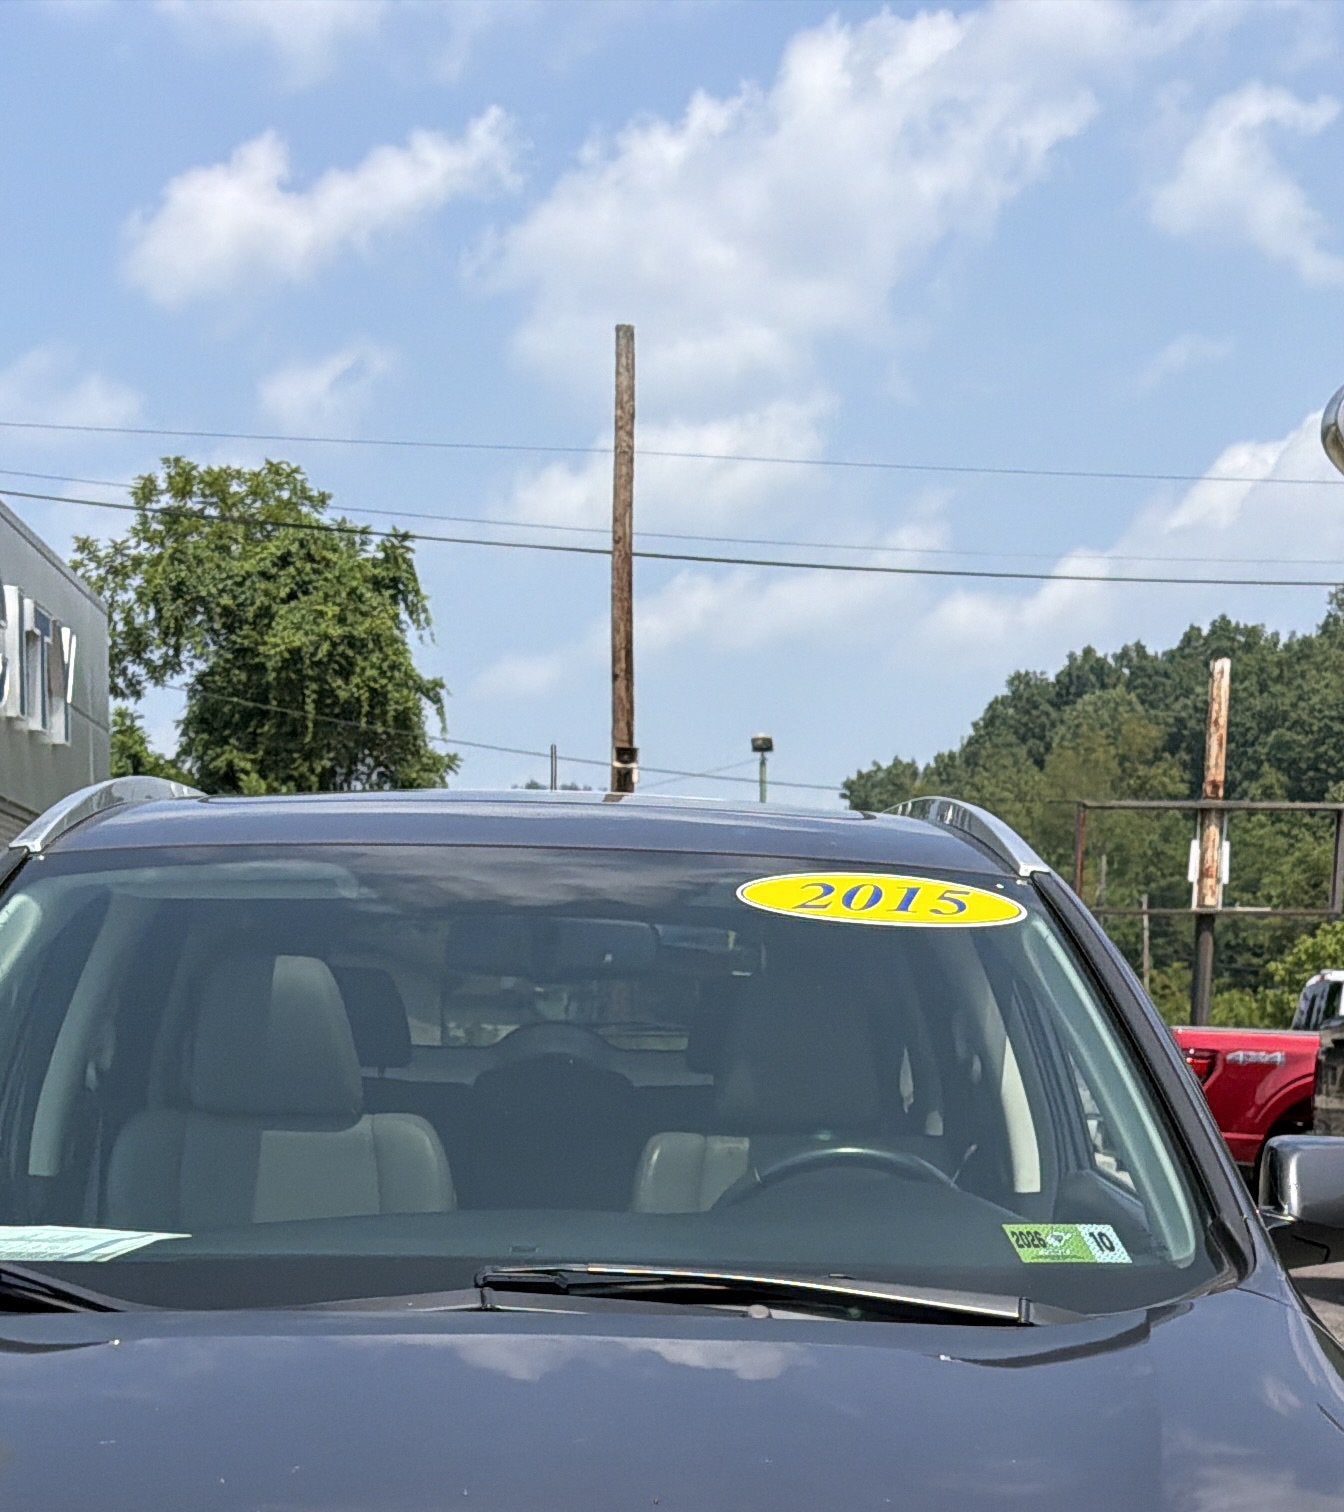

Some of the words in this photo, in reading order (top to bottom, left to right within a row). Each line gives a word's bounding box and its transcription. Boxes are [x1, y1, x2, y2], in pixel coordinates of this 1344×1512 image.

[793, 882, 972, 916] 2015
[1010, 1230, 1047, 1249] 2026
[1089, 1231, 1116, 1252] 10
